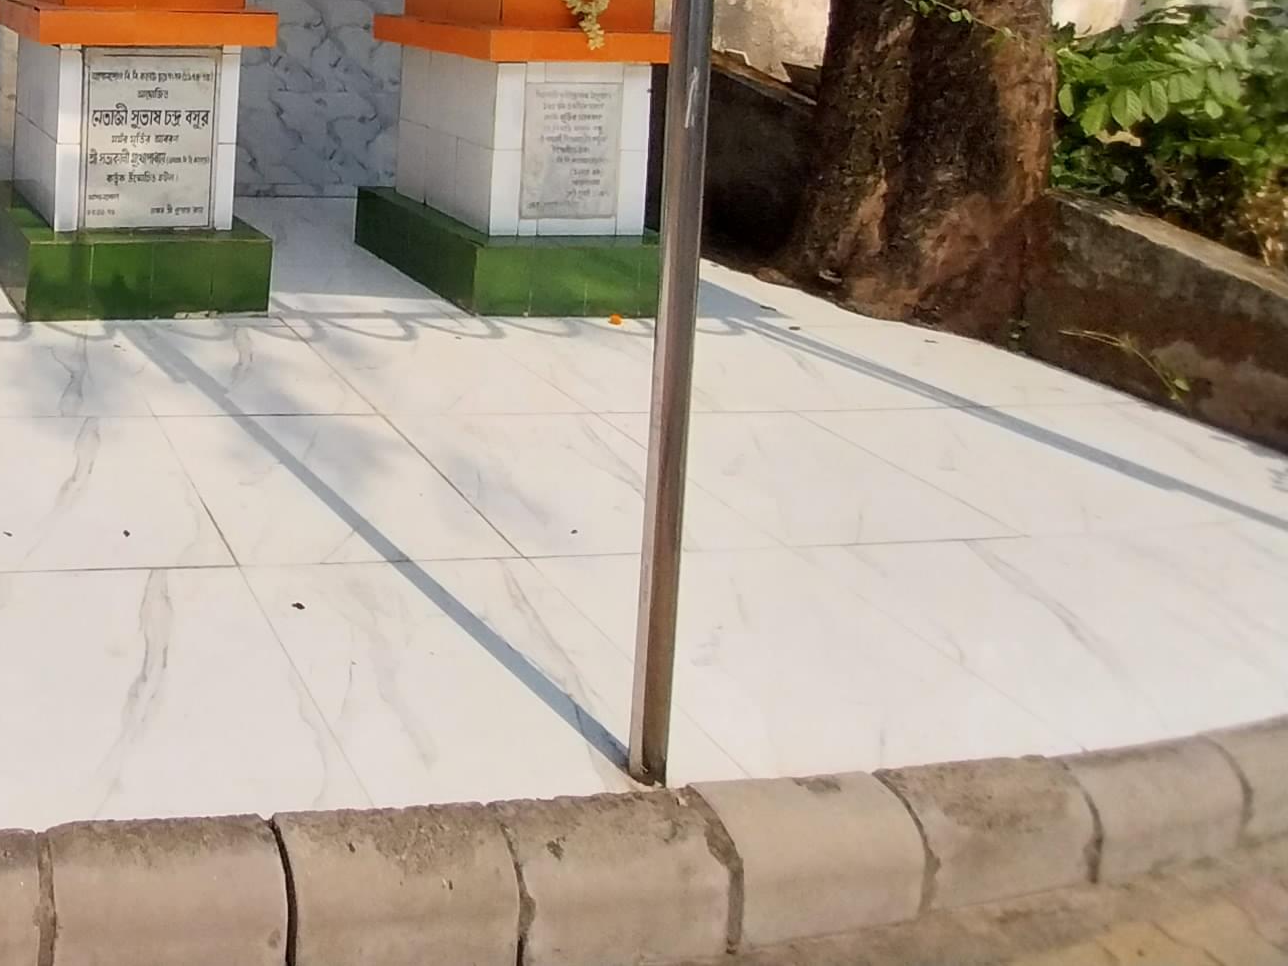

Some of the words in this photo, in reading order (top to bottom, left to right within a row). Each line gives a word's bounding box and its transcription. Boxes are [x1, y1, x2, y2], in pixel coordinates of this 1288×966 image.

[92, 102, 128, 127] নেতাজী
[130, 109, 162, 129] সুভাষ
[164, 110, 182, 127] চন্দ্র
[184, 110, 211, 129] বসুর
